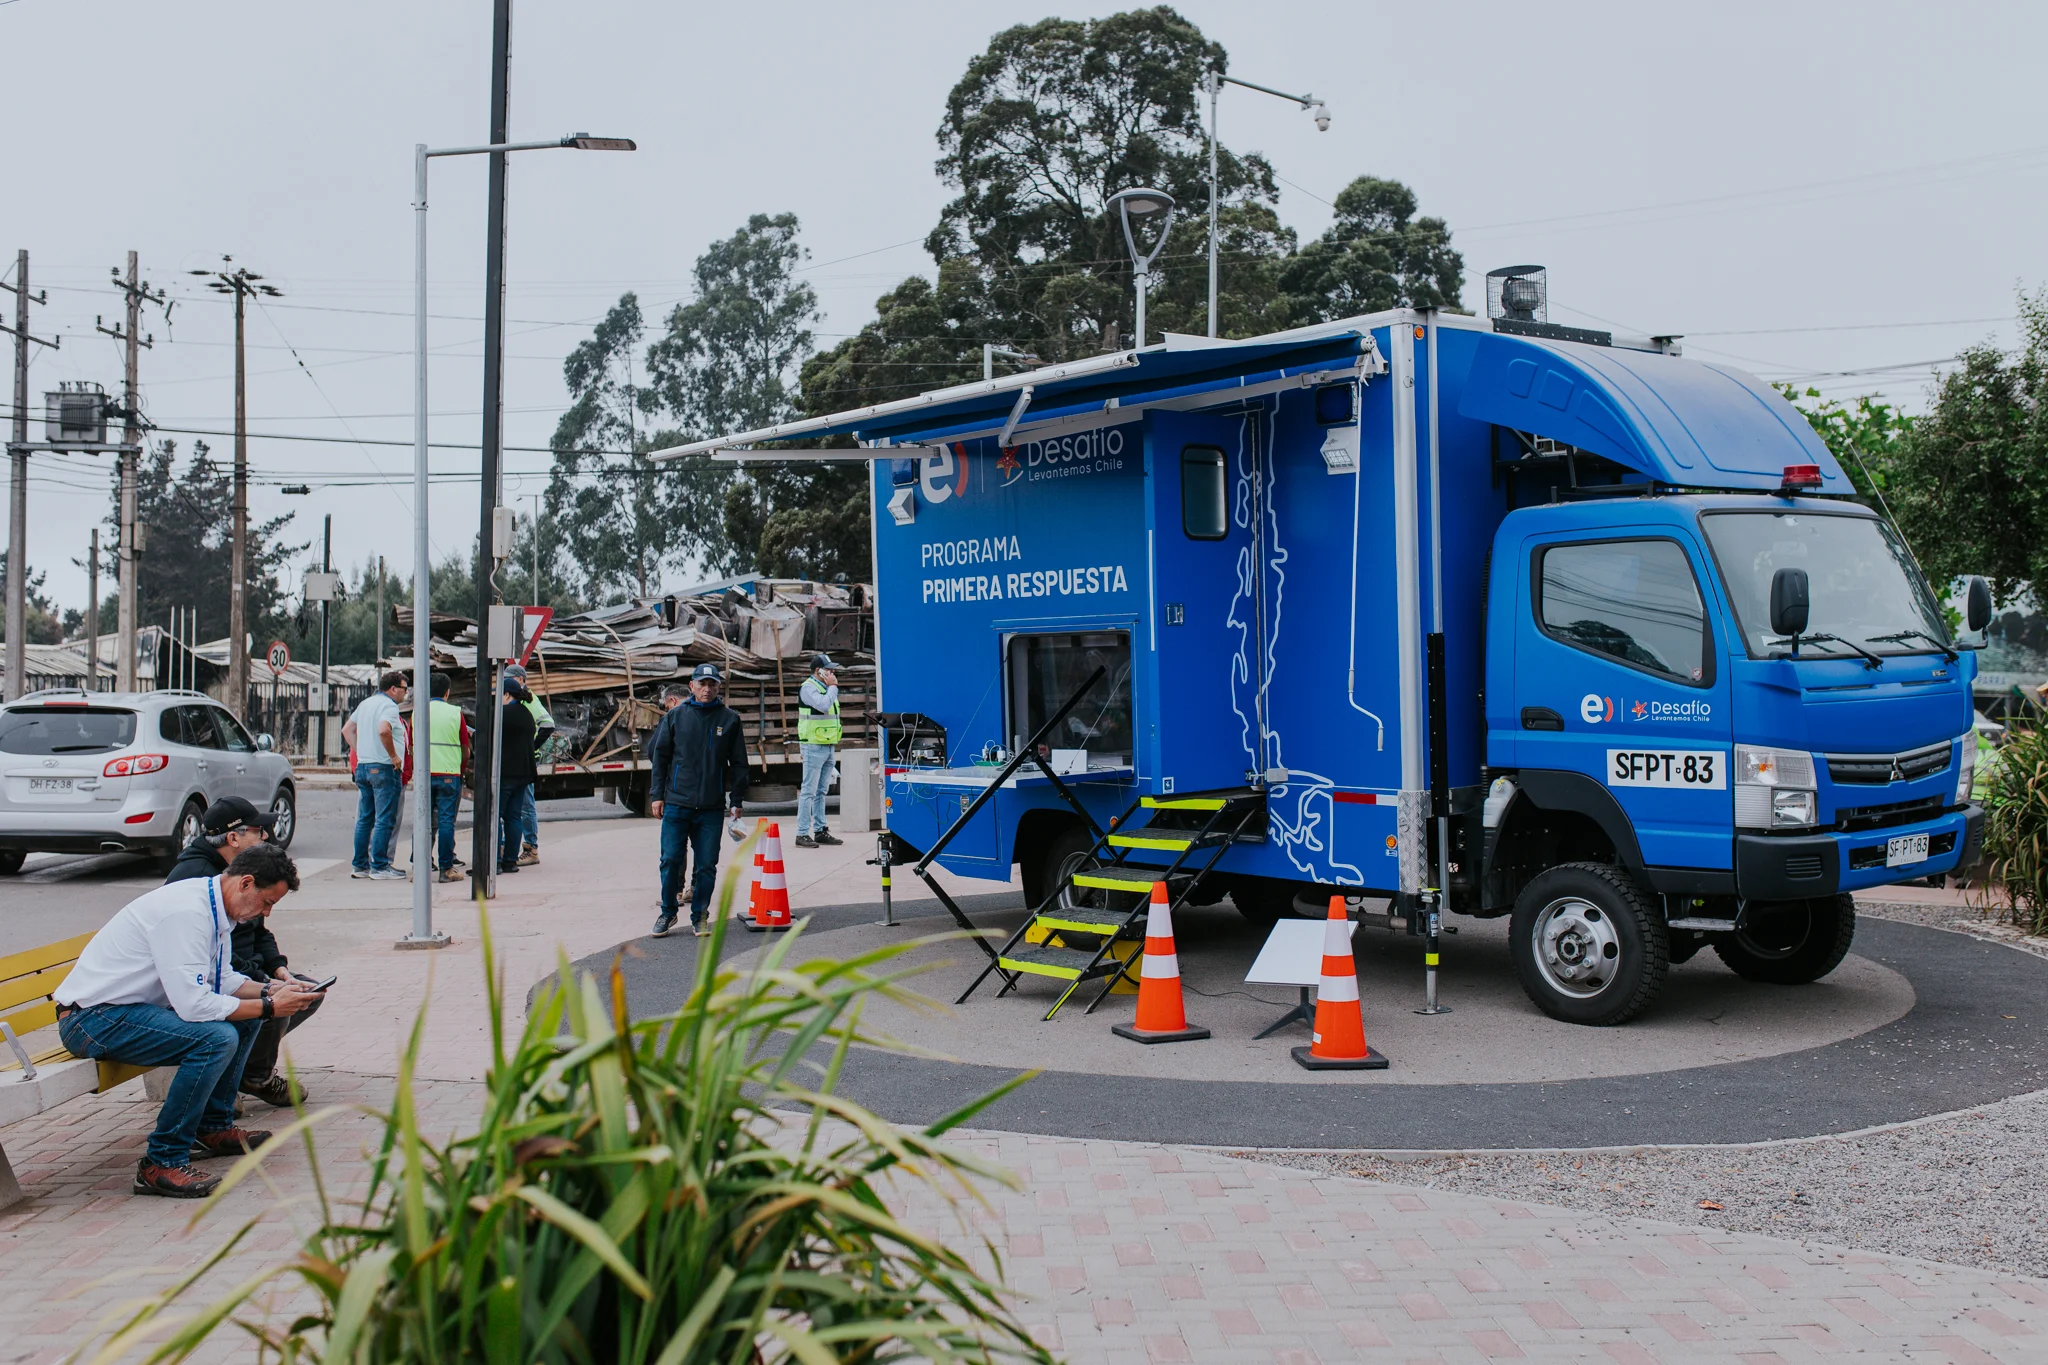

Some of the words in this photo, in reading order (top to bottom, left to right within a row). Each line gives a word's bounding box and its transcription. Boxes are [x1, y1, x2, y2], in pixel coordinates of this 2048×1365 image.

[1028, 464, 1092, 482] Levantemos
[1095, 459, 1123, 472] Chile
[921, 535, 1022, 568] PROGRAMA
[923, 575, 1003, 604] PRIMERA
[1007, 565, 1128, 598] RESPUESTA
[271, 649, 286, 667] 30
[1651, 700, 1711, 715] Desafío
